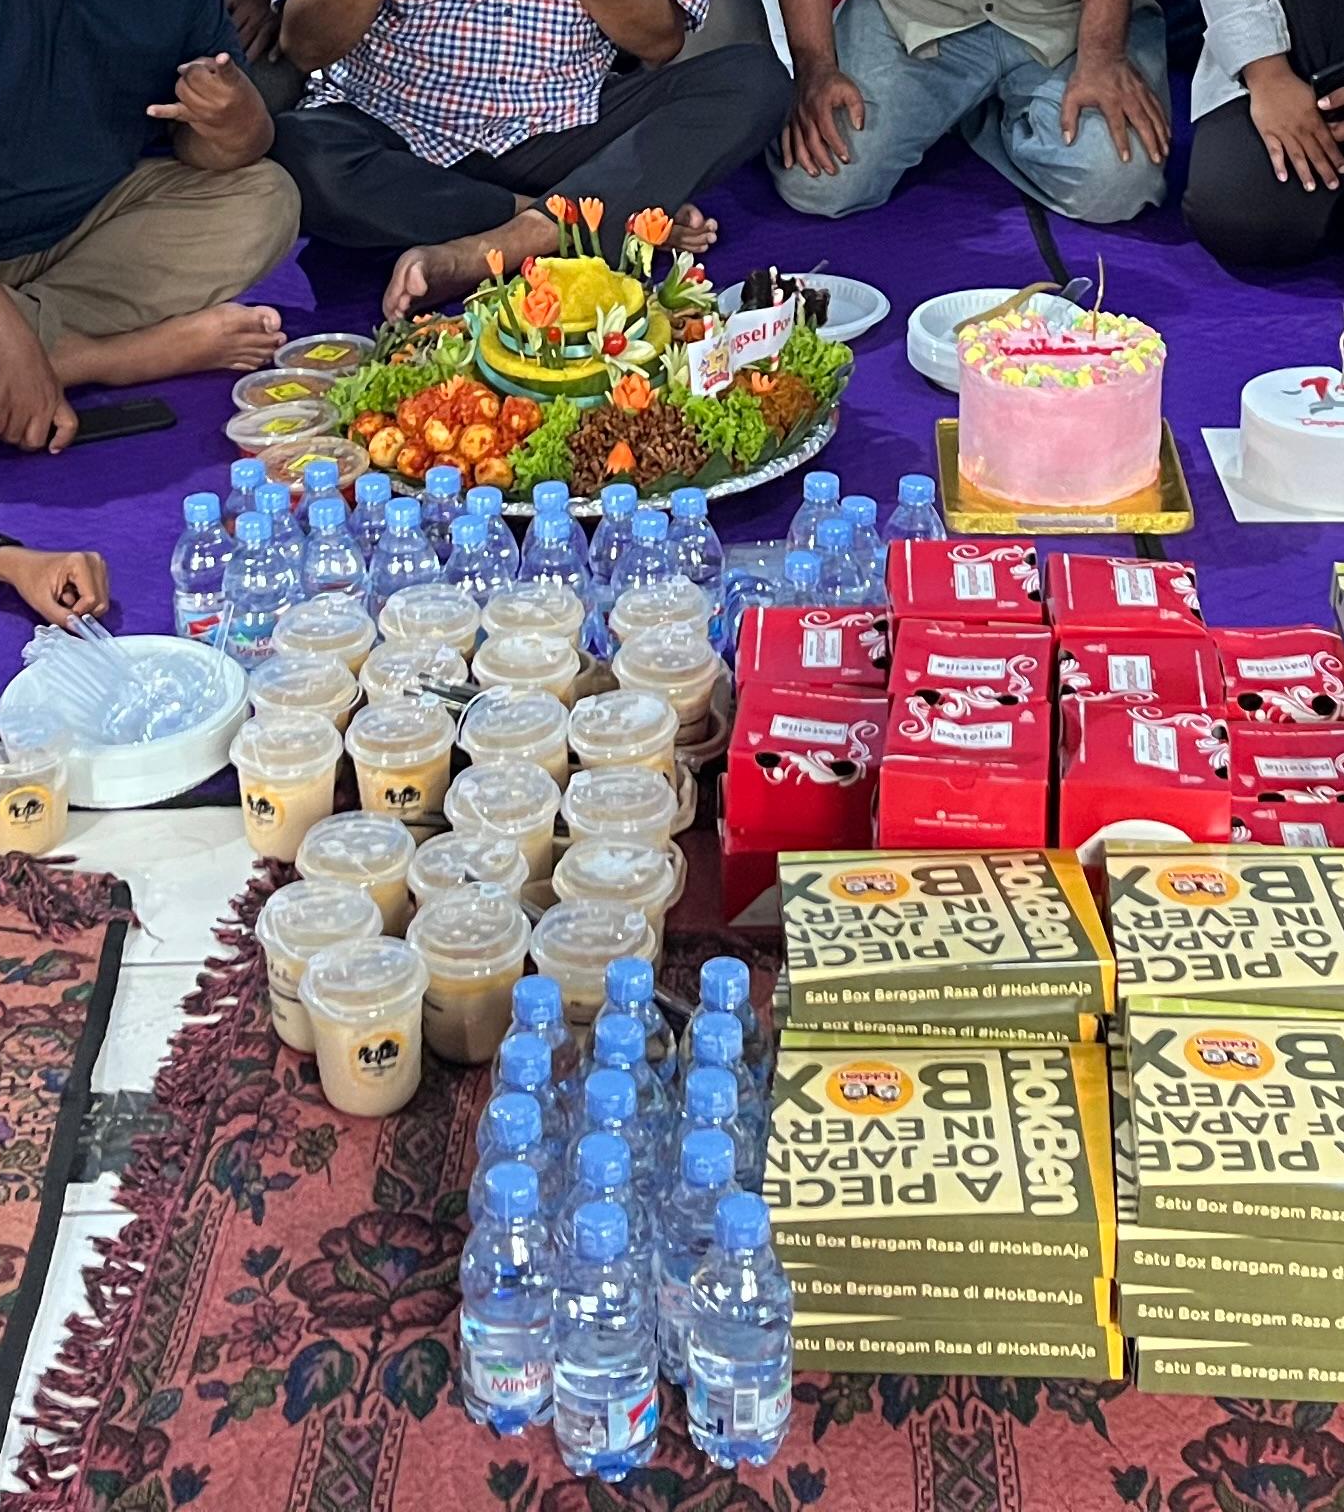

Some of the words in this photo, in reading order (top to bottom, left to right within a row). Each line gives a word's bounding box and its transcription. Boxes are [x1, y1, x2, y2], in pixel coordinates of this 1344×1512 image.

[943, 897, 992, 917] IN
[989, 852, 1079, 960] HokBen
[1274, 907, 1325, 927] IN
[938, 917, 998, 936] OF
[1272, 929, 1332, 948] OF
[788, 939, 949, 969] PIECE
[963, 933, 1005, 954] A
[1118, 952, 1282, 983] PIECE
[1295, 951, 1339, 977] A
[805, 990, 839, 1004] Satu
[843, 989, 870, 1003] Box
[875, 986, 940, 1004] Beragam
[944, 985, 978, 998] Rasa
[982, 984, 997, 997] di
[1001, 981, 1092, 996] #HokBenAja
[961, 1024, 975, 1038] di
[943, 1116, 995, 1140] IN
[1007, 1049, 1081, 1217] HokBen
[932, 1144, 1000, 1168] OF
[1139, 1139, 1320, 1173] PIECE
[762, 1172, 937, 1209] PIECE
[955, 1170, 1003, 1203] A
[1155, 1195, 1192, 1212] Satu
[1197, 1198, 1228, 1214] Box
[1233, 1201, 1306, 1220] Beragam
[776, 1231, 811, 1246] Satu
[816, 1233, 846, 1248] Box
[850, 1235, 922, 1253] Beragam
[926, 1238, 964, 1253] Rasa
[968, 1238, 985, 1254] di
[989, 1239, 1089, 1259] #HokBenAja
[1133, 1251, 1170, 1267] Satu
[1175, 1254, 1206, 1270] Box
[1211, 1256, 1284, 1277] Beragam
[1288, 1262, 1328, 1279] Rasa
[812, 1280, 842, 1295] Box
[846, 1281, 917, 1298] Beragam
[922, 1283, 959, 1299] Rasa
[964, 1284, 979, 1300] di
[983, 1286, 1084, 1306] #HokBenAja
[1137, 1304, 1174, 1320] Satu
[1178, 1305, 1209, 1322] Box
[1214, 1309, 1287, 1328] Beragam
[1292, 1313, 1331, 1329] Rasa
[791, 1338, 820, 1352] atu
[825, 1338, 854, 1352] Box
[859, 1339, 930, 1355] Beragam
[935, 1340, 972, 1354] Rasa
[976, 1341, 992, 1354] di
[996, 1342, 1096, 1359] #HokBenAja
[1154, 1360, 1191, 1377] Satu
[1195, 1361, 1227, 1377] Box
[1232, 1364, 1304, 1382] Beragam
